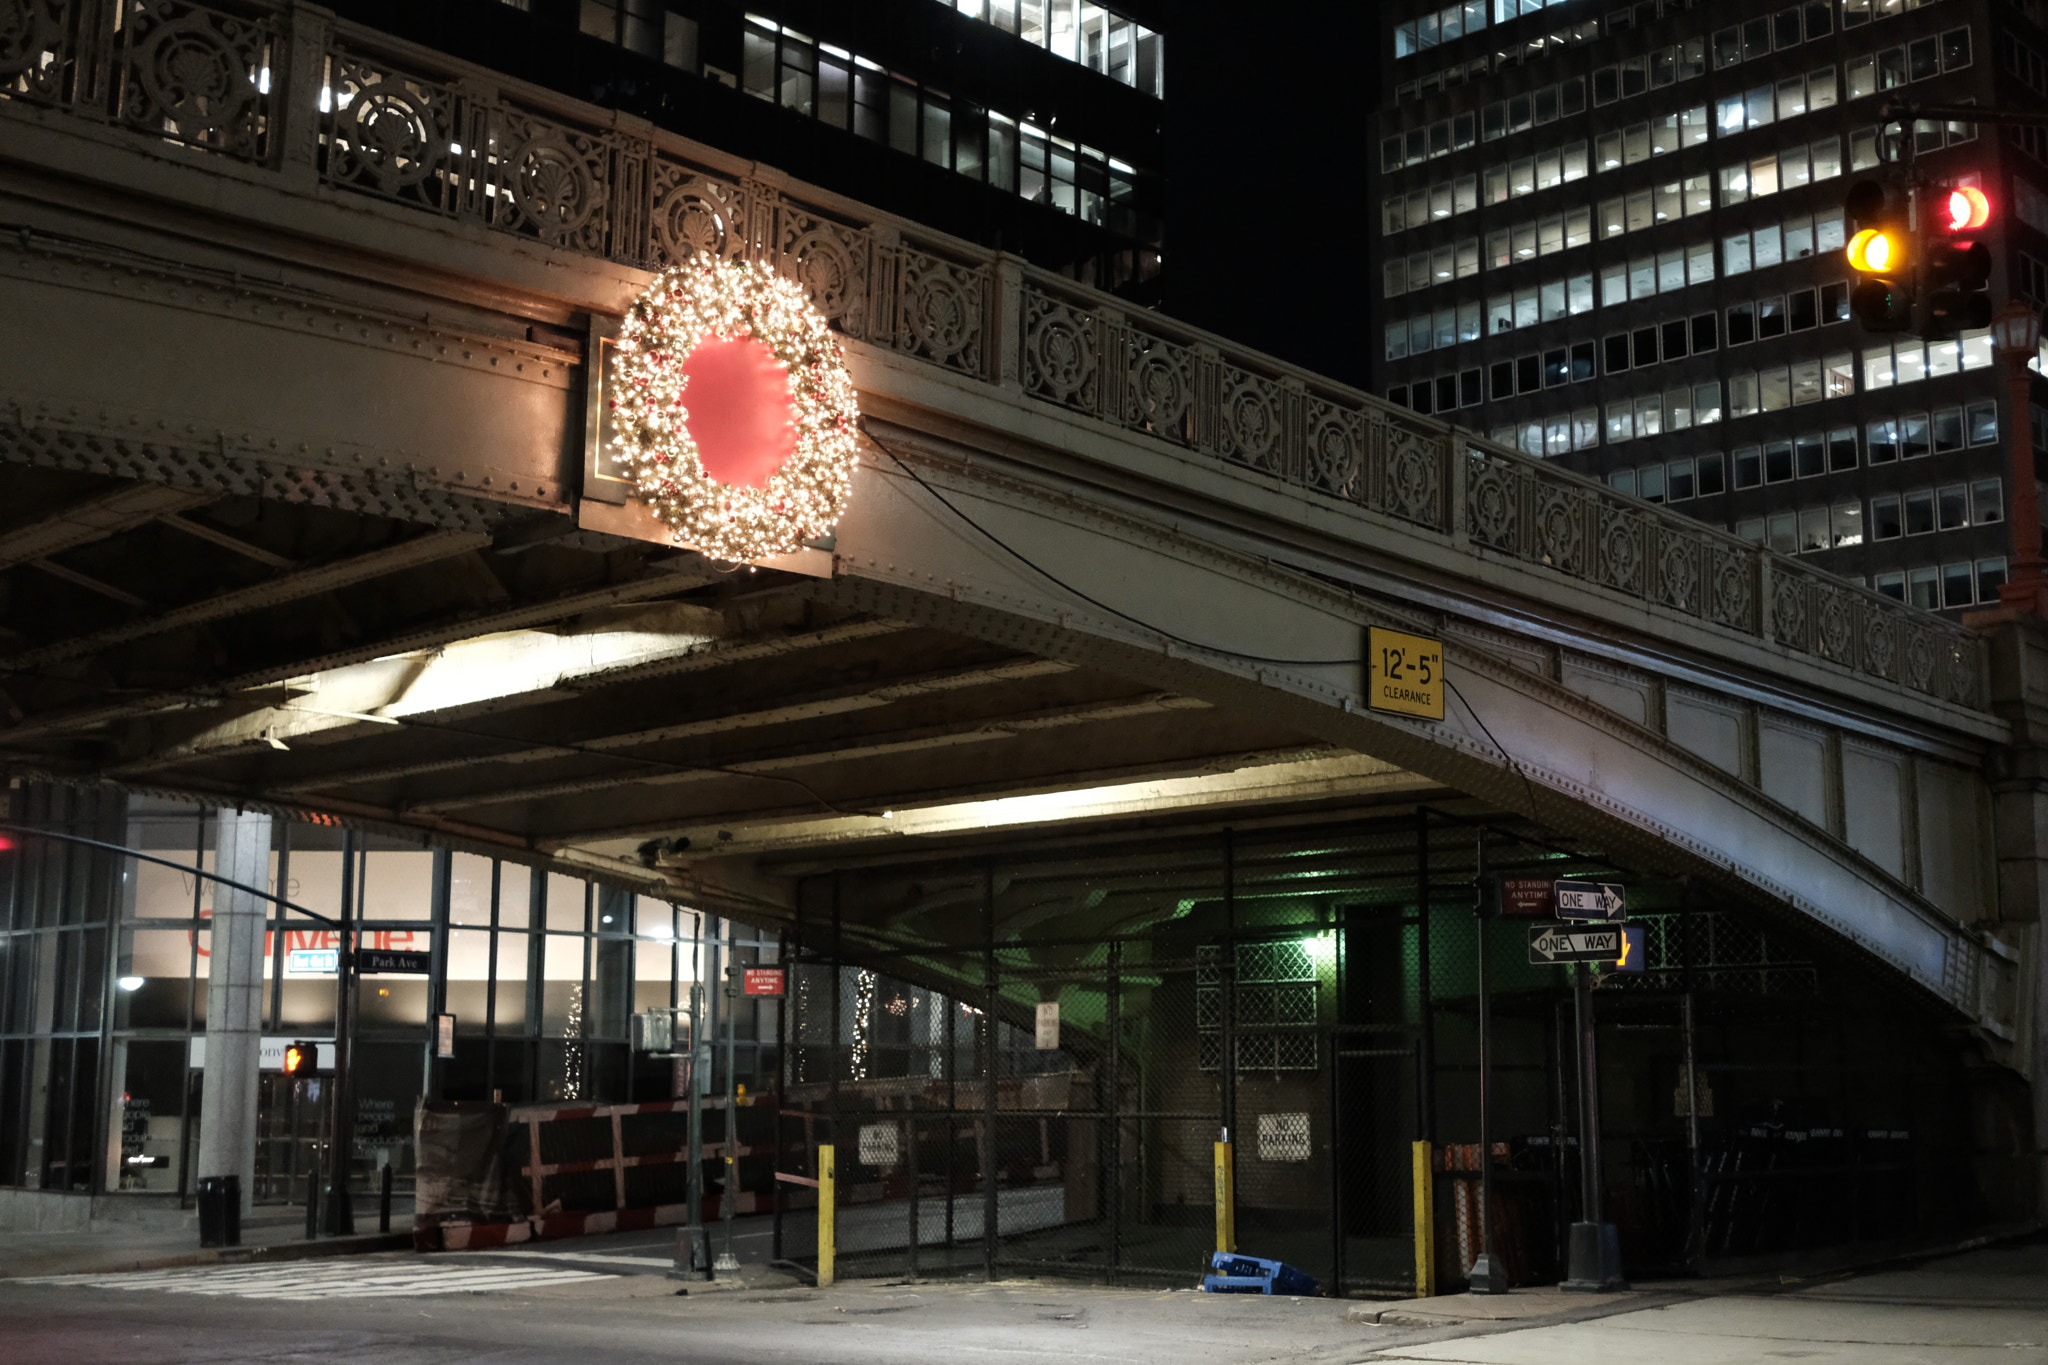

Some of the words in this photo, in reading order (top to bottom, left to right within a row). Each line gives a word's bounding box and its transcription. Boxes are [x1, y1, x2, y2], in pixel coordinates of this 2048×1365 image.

[1382, 647, 1439, 685] 12'-5"
[1383, 685, 1432, 706] CLEARANCE
[1504, 881, 1515, 889] NO
[1511, 891, 1549, 899] ANYTIME
[1561, 893, 1584, 908] ONE
[1594, 895, 1617, 909] WAY
[1539, 936, 1569, 952] ONE
[1584, 934, 1613, 950] WAY
[372, 955, 395, 968] Park
[398, 956, 418, 969] Ave
[1276, 1119, 1290, 1131] NO
[1262, 1132, 1306, 1146] PARKING
